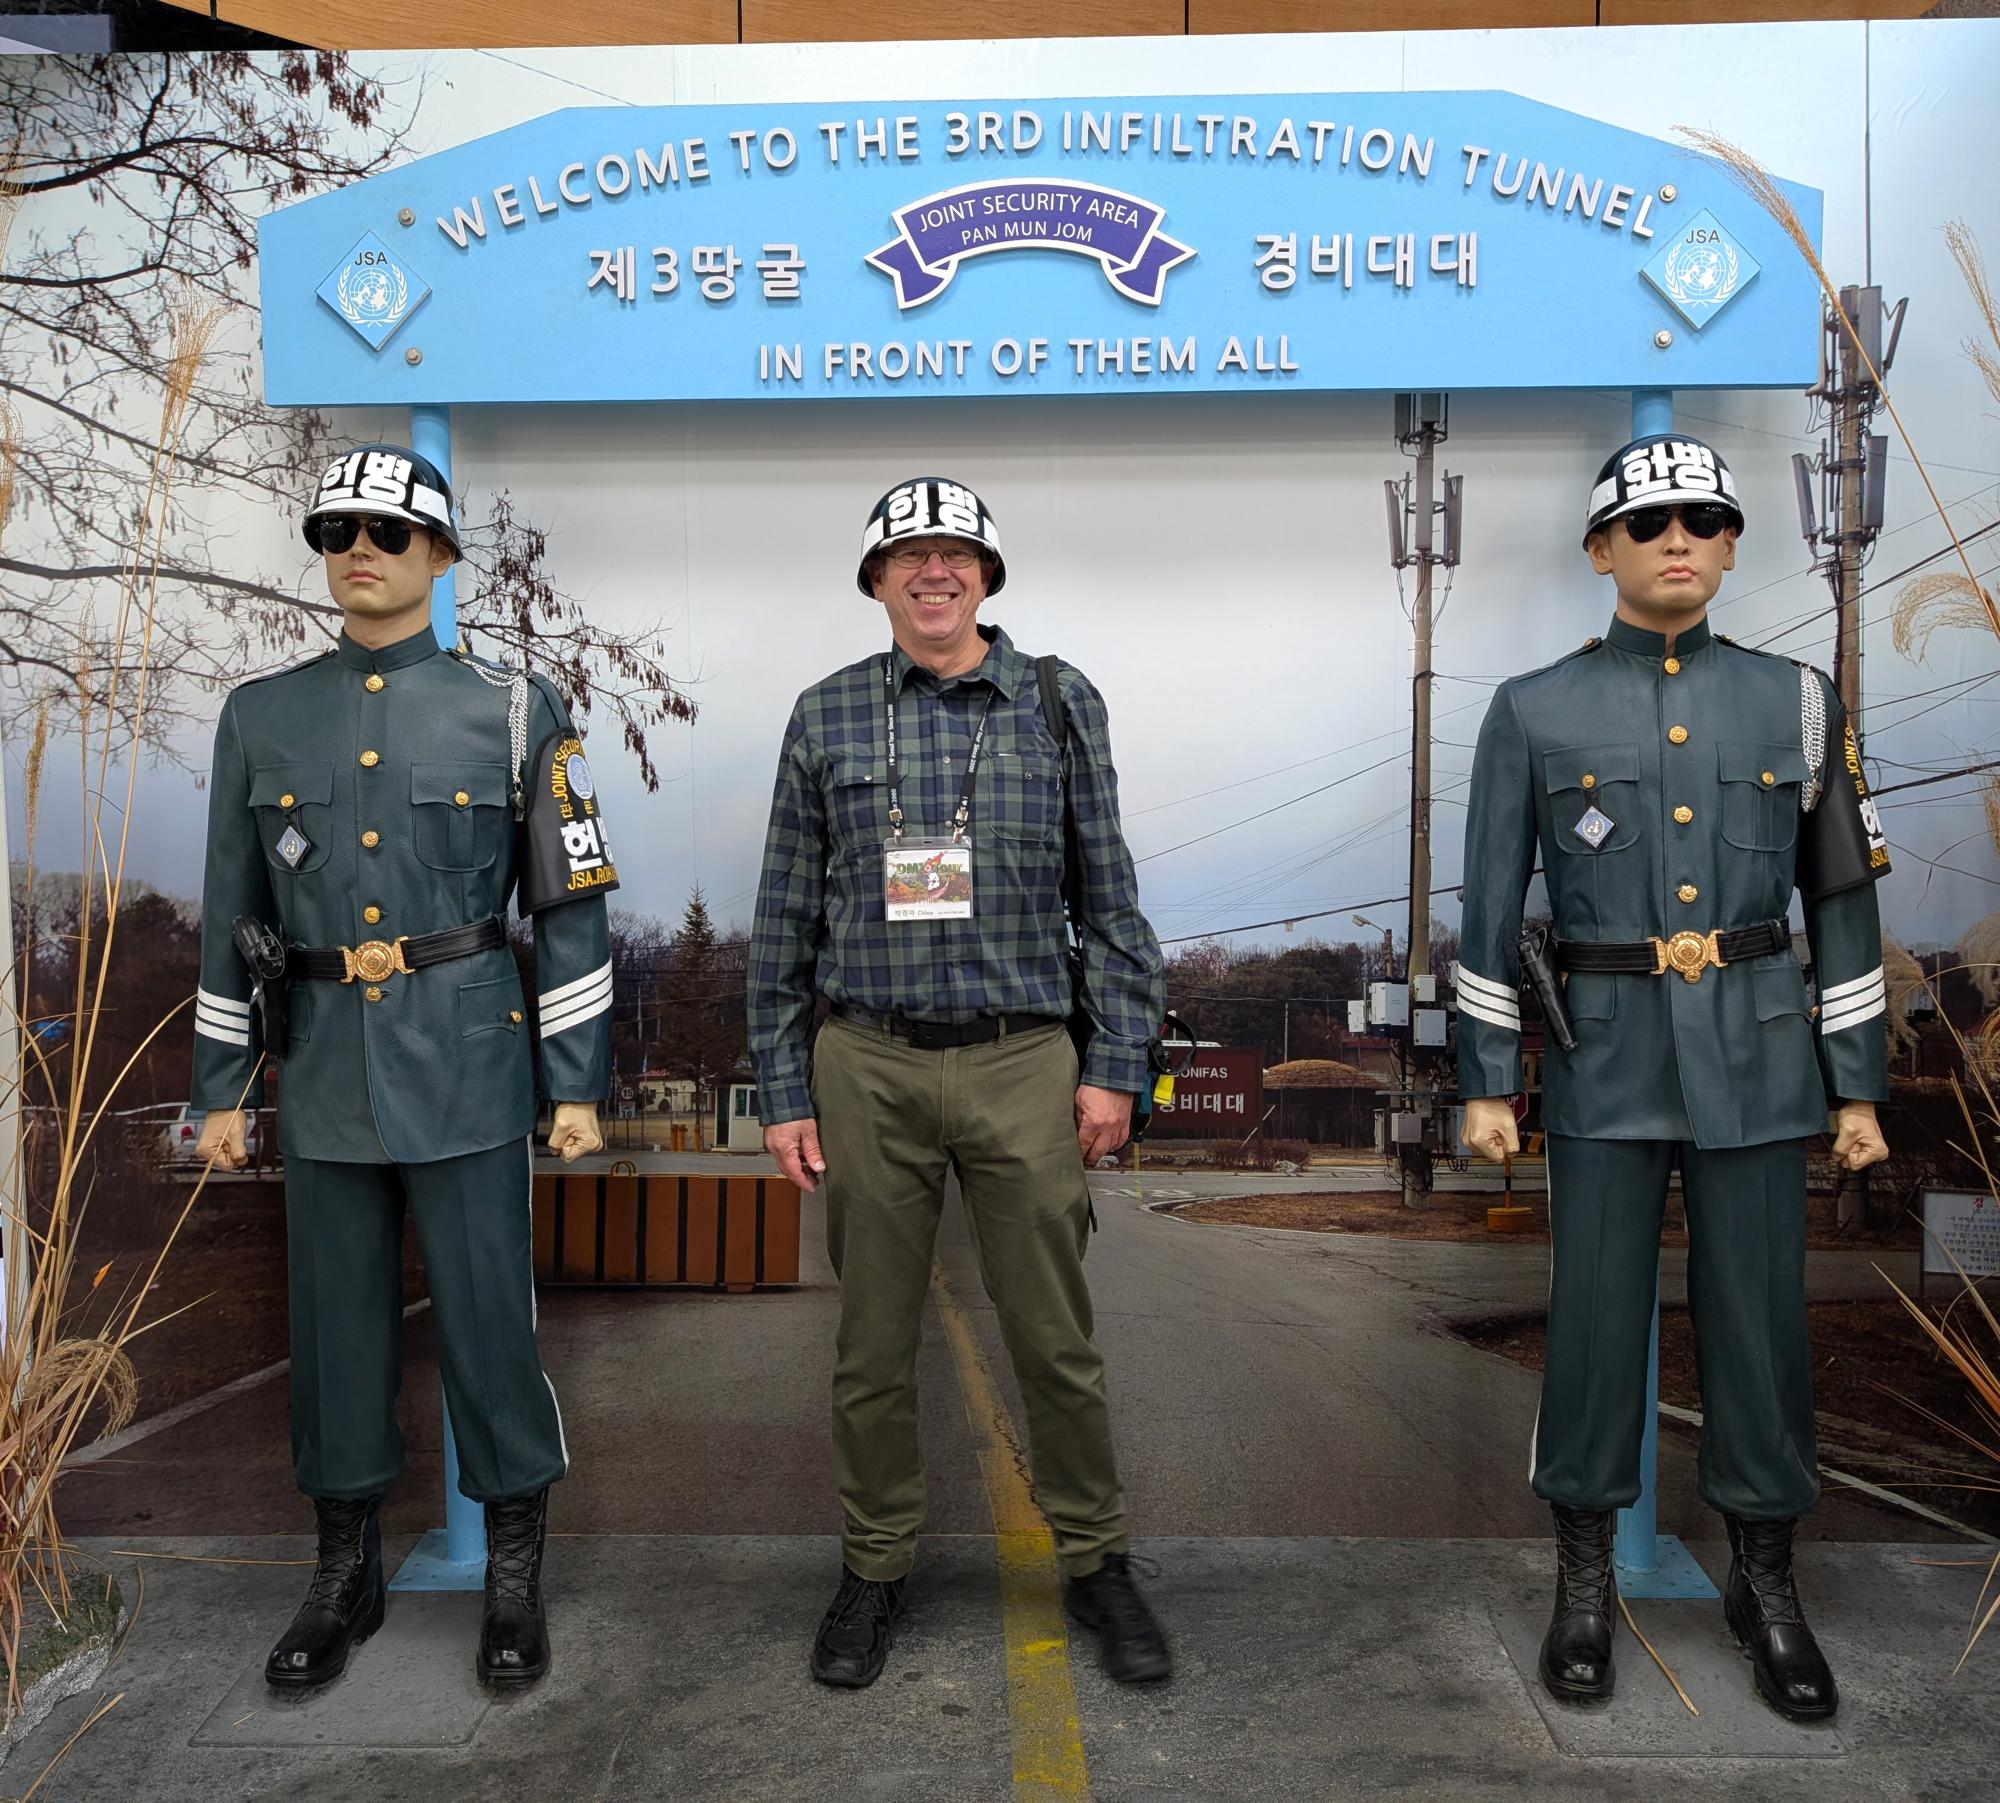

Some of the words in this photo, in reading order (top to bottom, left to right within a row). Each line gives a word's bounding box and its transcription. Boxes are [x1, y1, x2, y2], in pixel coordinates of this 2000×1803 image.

[436, 137, 712, 248] WELCOME
[728, 127, 798, 171] TO
[819, 116, 920, 162] THE
[945, 110, 1043, 154] 3RD
[1062, 111, 1436, 178] INFILTRATION
[1462, 144, 1656, 239] TUNNEL
[919, 199, 977, 232] JOINT
[982, 192, 1082, 215] SECURITY
[1087, 198, 1139, 229] AREA
[961, 224, 997, 245] PAN
[1004, 221, 1047, 237] MUN
[1053, 222, 1093, 242] JOM
[1685, 229, 1721, 244] JSA
[354, 251, 388, 266] JSA
[588, 243, 807, 302] 제3땅굴
[1254, 231, 1478, 290] 경비대대
[759, 344, 803, 381] IN
[823, 340, 972, 380] FRONT
[991, 337, 1049, 376] OF
[1068, 335, 1197, 375] THEM
[1217, 334, 1299, 372] ALL
[319, 452, 412, 505] 헌병
[1622, 442, 1718, 500] 헌병
[888, 482, 979, 535] 헌병
[1844, 738, 1860, 778] JOINT
[551, 763, 569, 802] JOINT
[1174, 1066, 1228, 1079] ONIFAS
